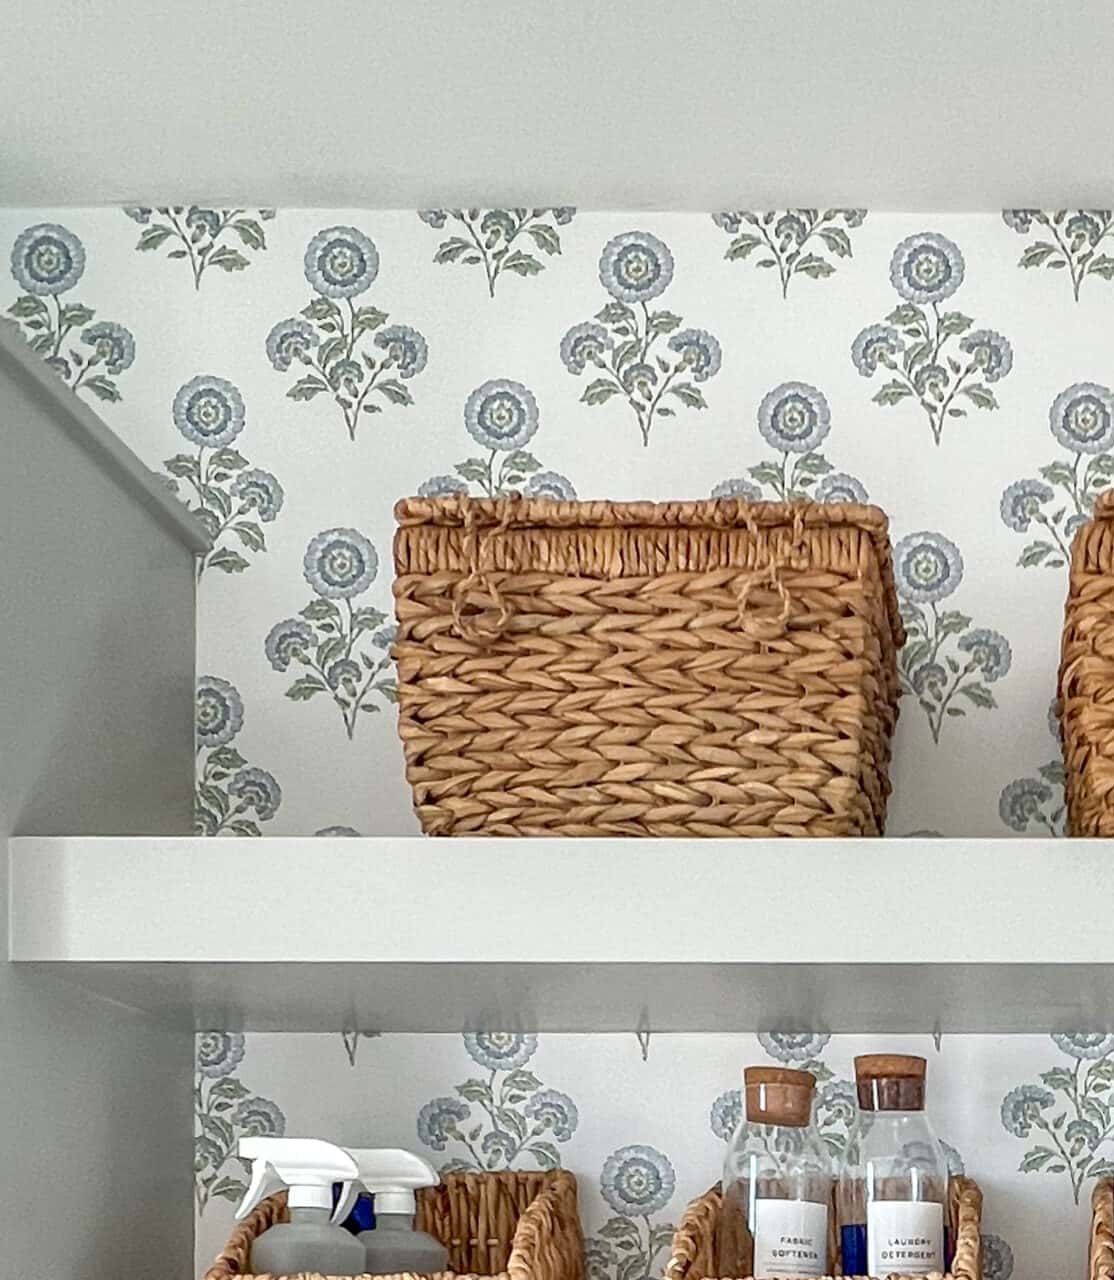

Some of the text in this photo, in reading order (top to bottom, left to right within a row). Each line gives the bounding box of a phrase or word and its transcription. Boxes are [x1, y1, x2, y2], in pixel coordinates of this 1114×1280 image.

[780, 1236, 814, 1247] FABRIC
[888, 1237, 932, 1247] LAUNDRY
[772, 1249, 820, 1260] SOFTENER
[881, 1250, 937, 1260] DETERGENT
